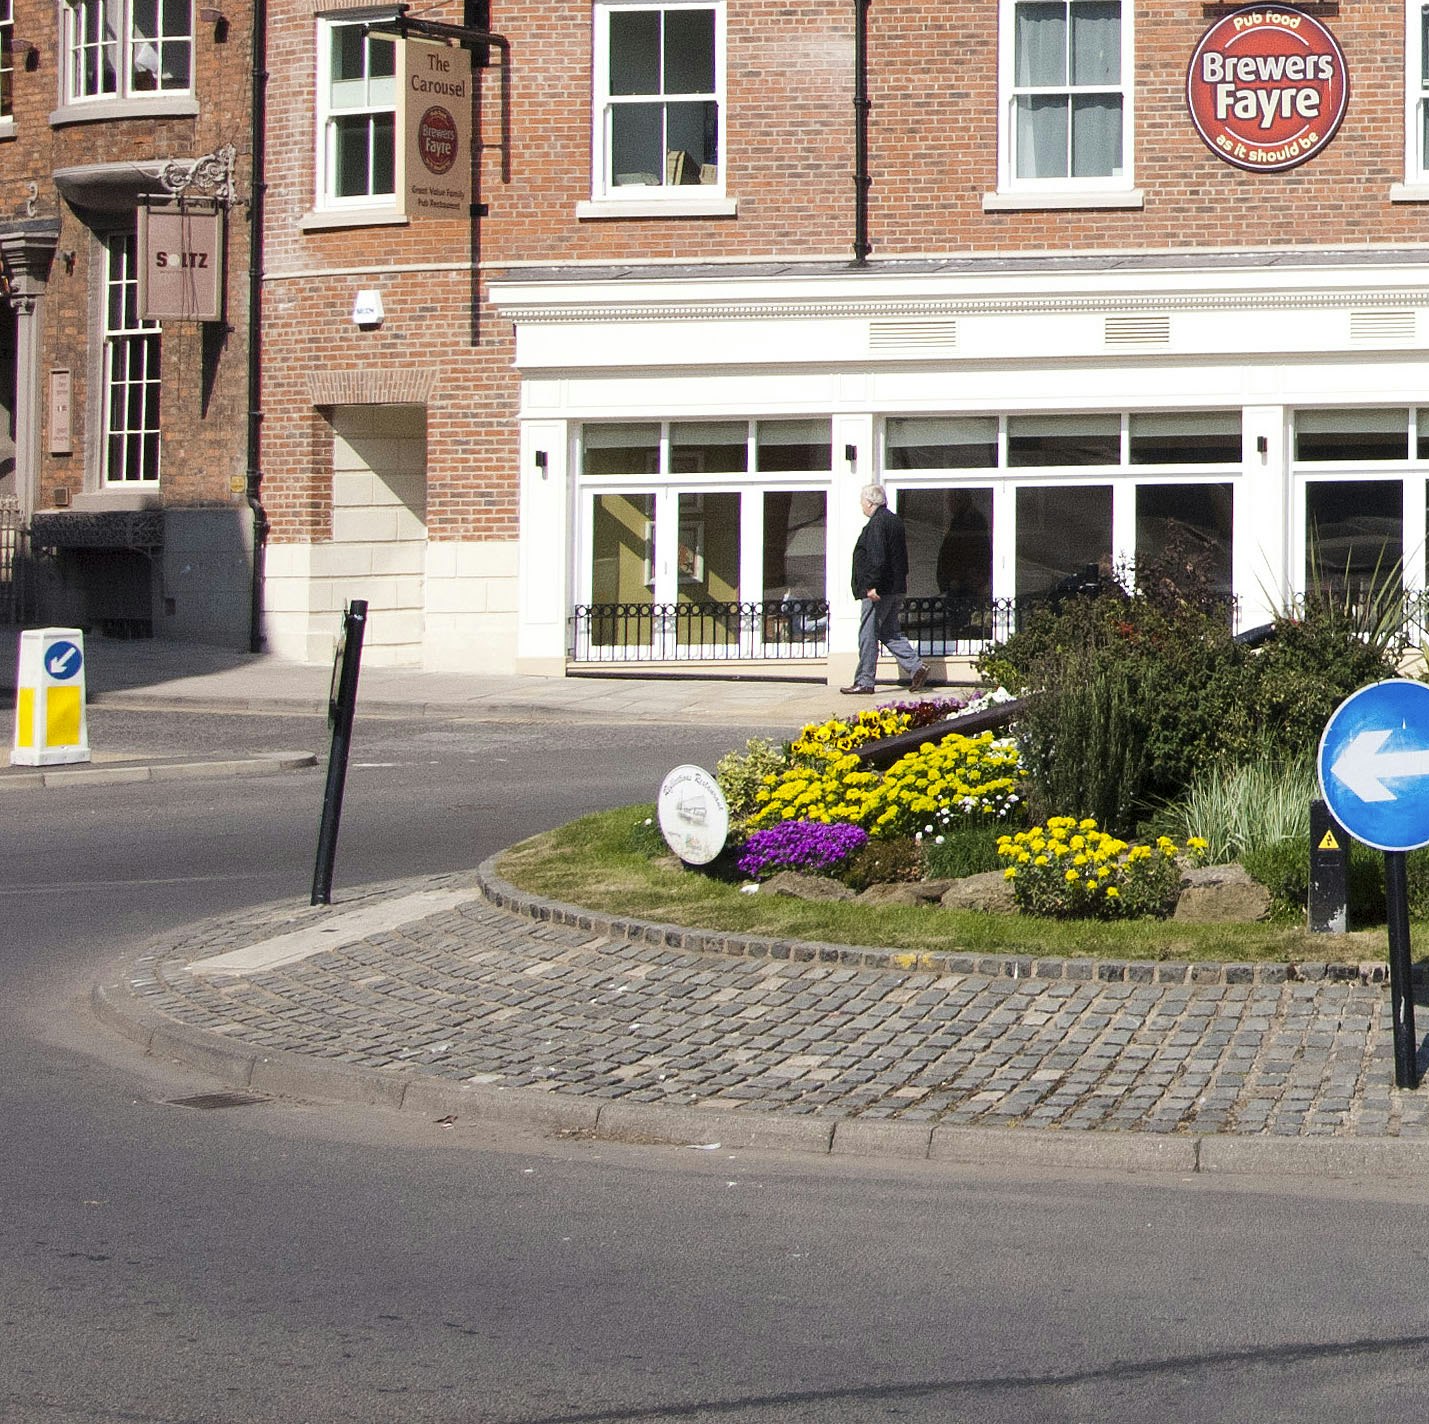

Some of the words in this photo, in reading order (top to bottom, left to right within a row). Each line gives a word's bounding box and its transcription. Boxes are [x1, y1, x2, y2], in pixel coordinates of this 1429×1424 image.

[1233, 12, 1263, 31] Pub
[1265, 11, 1302, 29] food
[427, 54, 451, 73] The
[1202, 51, 1334, 83] Brewers
[411, 75, 466, 98] Carousel
[1216, 83, 1321, 129] Fayre
[422, 124, 455, 141] Brewers
[425, 138, 452, 157] Fayre
[1216, 133, 1235, 152] as
[1234, 143, 1247, 158] it
[1248, 145, 1300, 162] should
[1300, 131, 1319, 148] be
